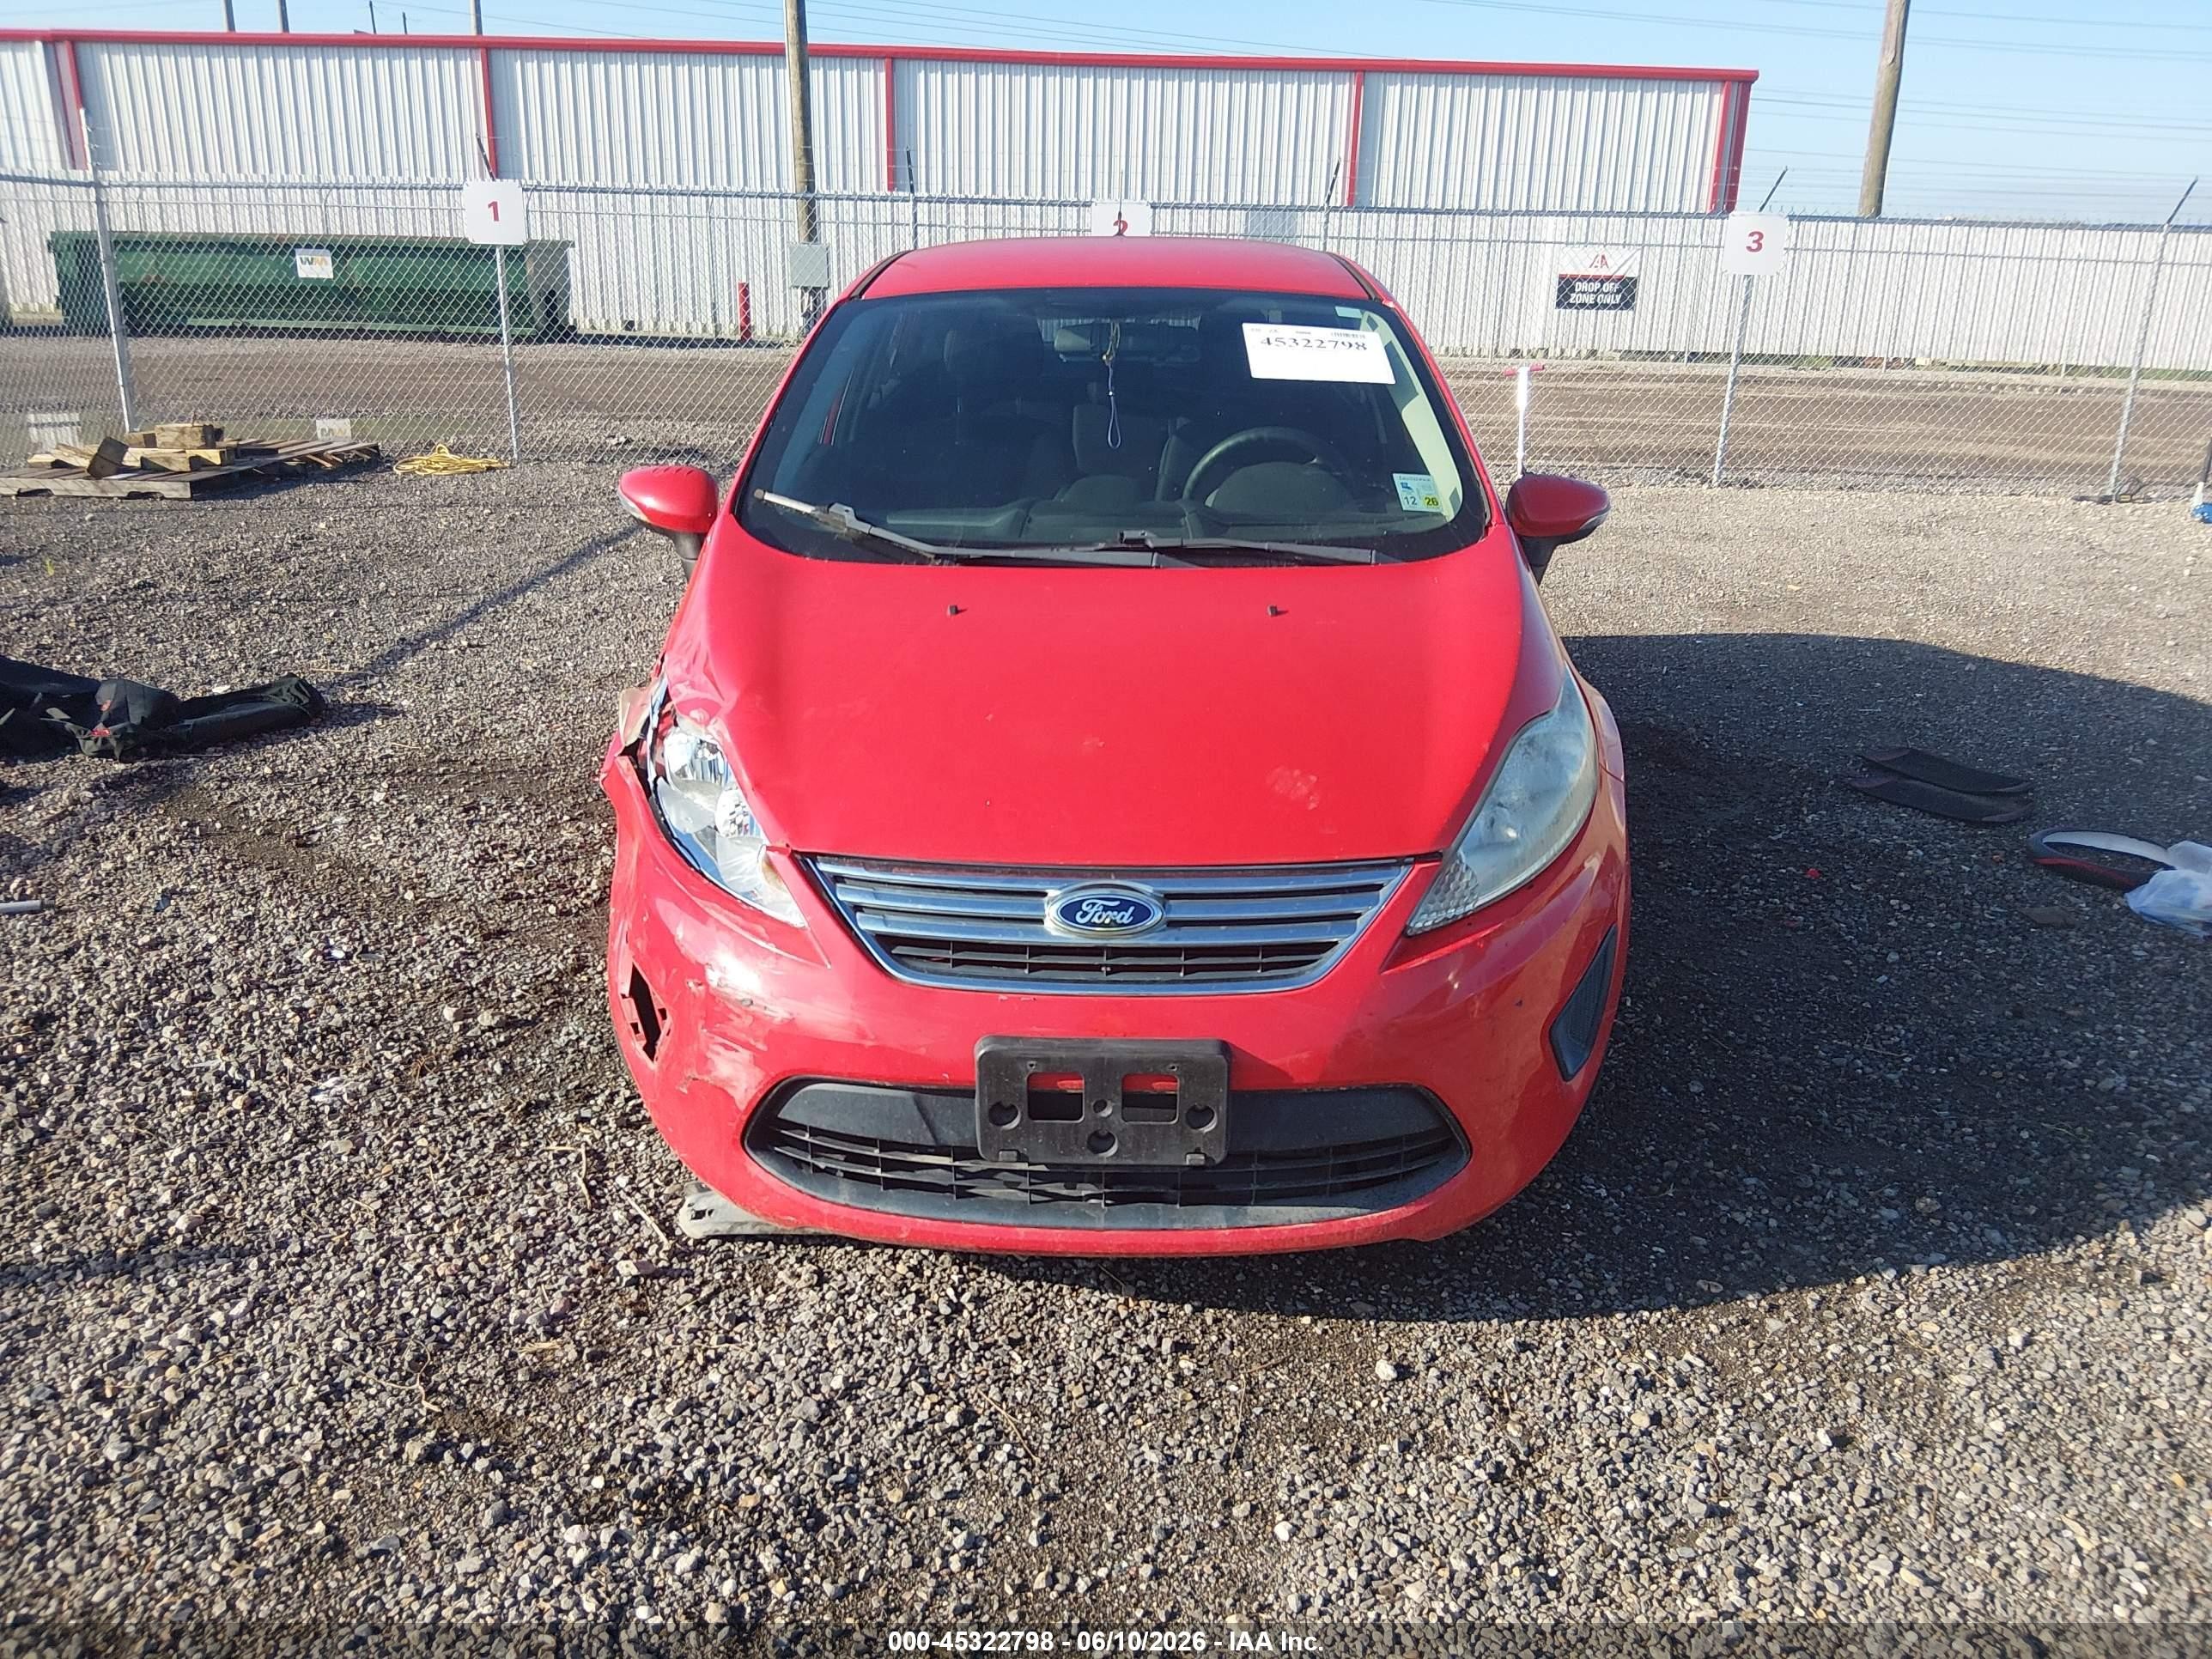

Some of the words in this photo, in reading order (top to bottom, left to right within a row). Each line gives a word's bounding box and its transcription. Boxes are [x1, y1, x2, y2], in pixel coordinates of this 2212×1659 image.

[487, 200, 500, 222] 1
[1112, 219, 1128, 236] 2
[1745, 230, 1765, 252] 3
[299, 256, 329, 266] WM
[1574, 282, 1601, 293] DROP
[1602, 282, 1620, 293] OFF
[1569, 293, 1595, 304] ZONE
[1597, 293, 1622, 305] ONLY
[1261, 336, 1368, 351] 45322798
[1404, 495, 1418, 506] 12
[1425, 496, 1439, 507] 26
[1075, 898, 1135, 925] Ford
